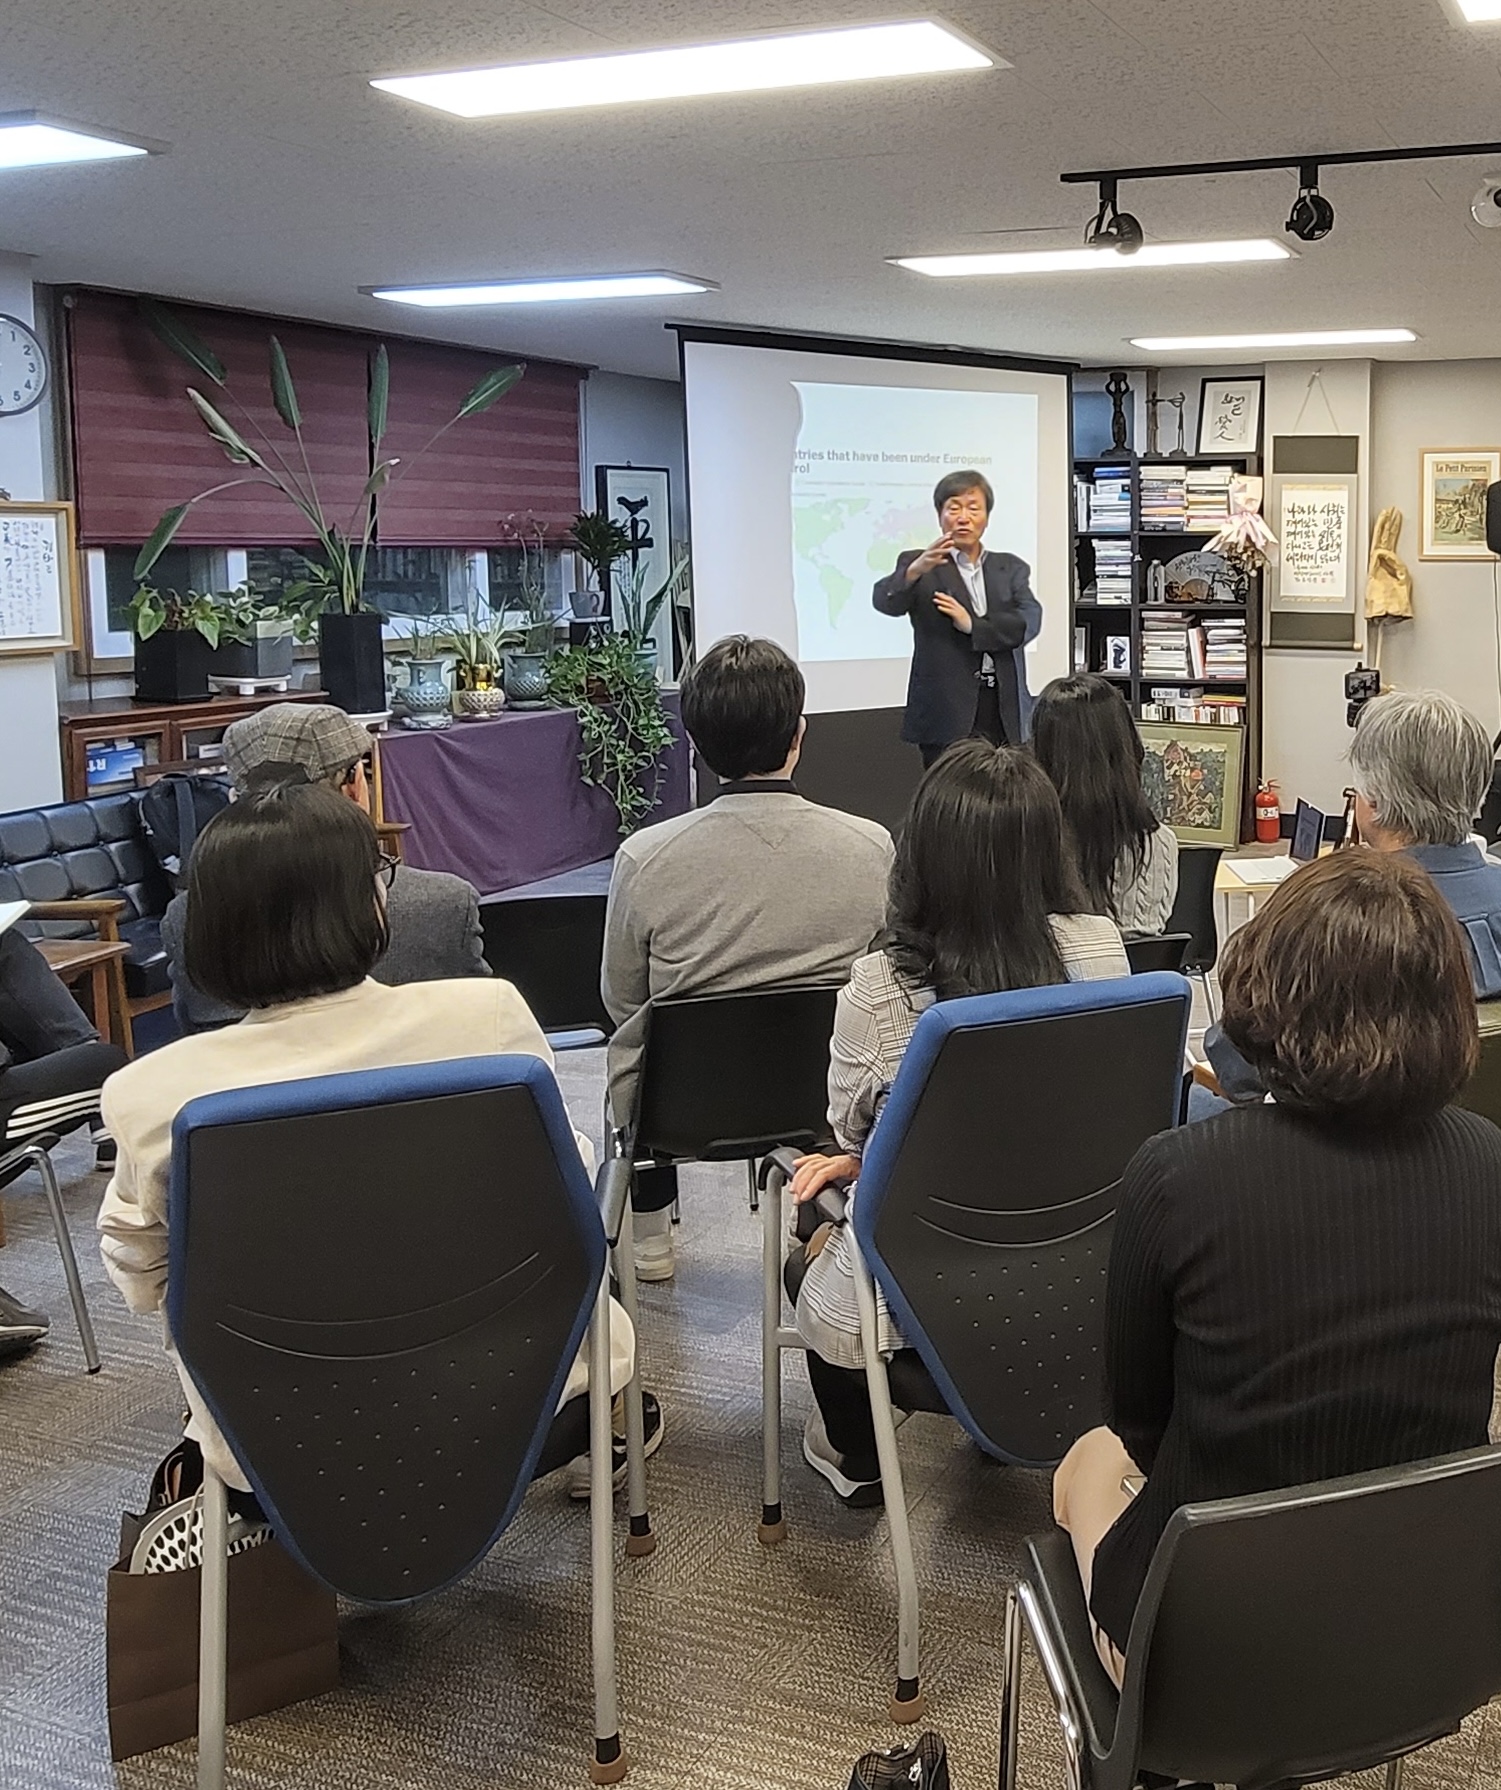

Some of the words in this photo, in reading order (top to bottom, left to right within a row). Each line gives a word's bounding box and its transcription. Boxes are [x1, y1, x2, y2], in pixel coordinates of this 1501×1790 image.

[11, 331, 16, 341] 1
[24, 345, 31, 356] 2
[28, 363, 36, 373] 3
[24, 380, 32, 390] 4
[13, 391, 21, 402] 5
[827, 450, 850, 462] that
[852, 450, 879, 462] have
[881, 451, 908, 463] been
[910, 452, 940, 463] under
[943, 453, 992, 466] European
